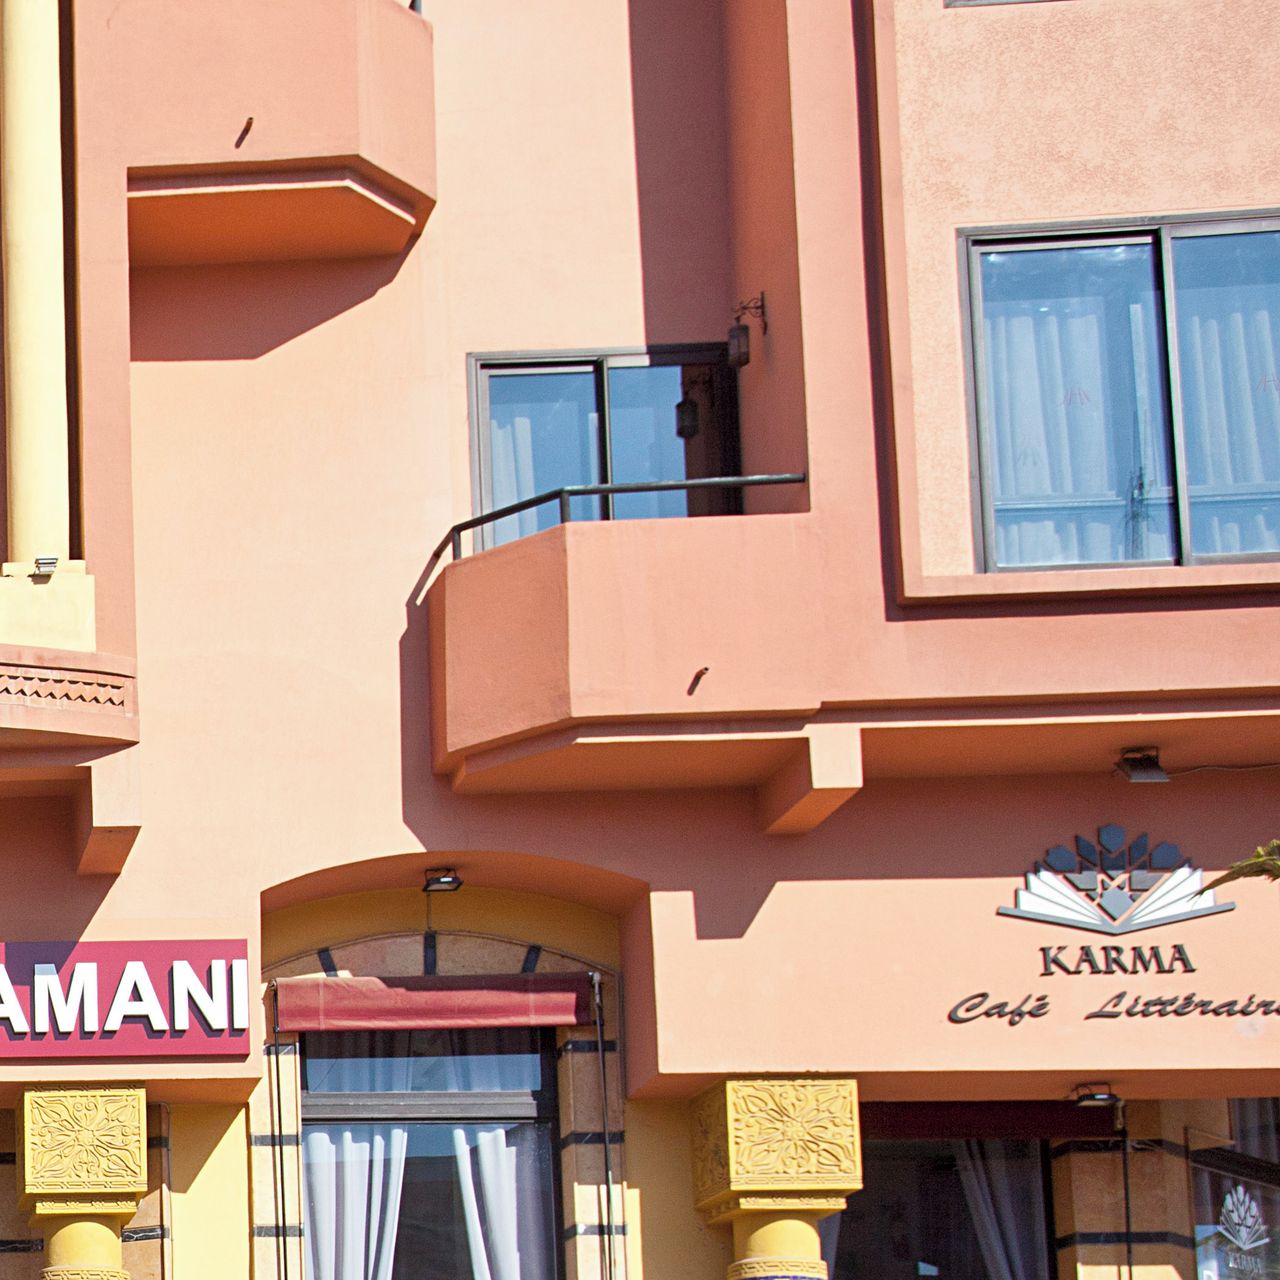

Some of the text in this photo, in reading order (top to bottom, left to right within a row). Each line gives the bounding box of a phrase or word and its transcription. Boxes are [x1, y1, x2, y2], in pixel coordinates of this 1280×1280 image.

[1039, 944, 1197, 976] KARMA
[948, 991, 1280, 1026] Café Littérair
